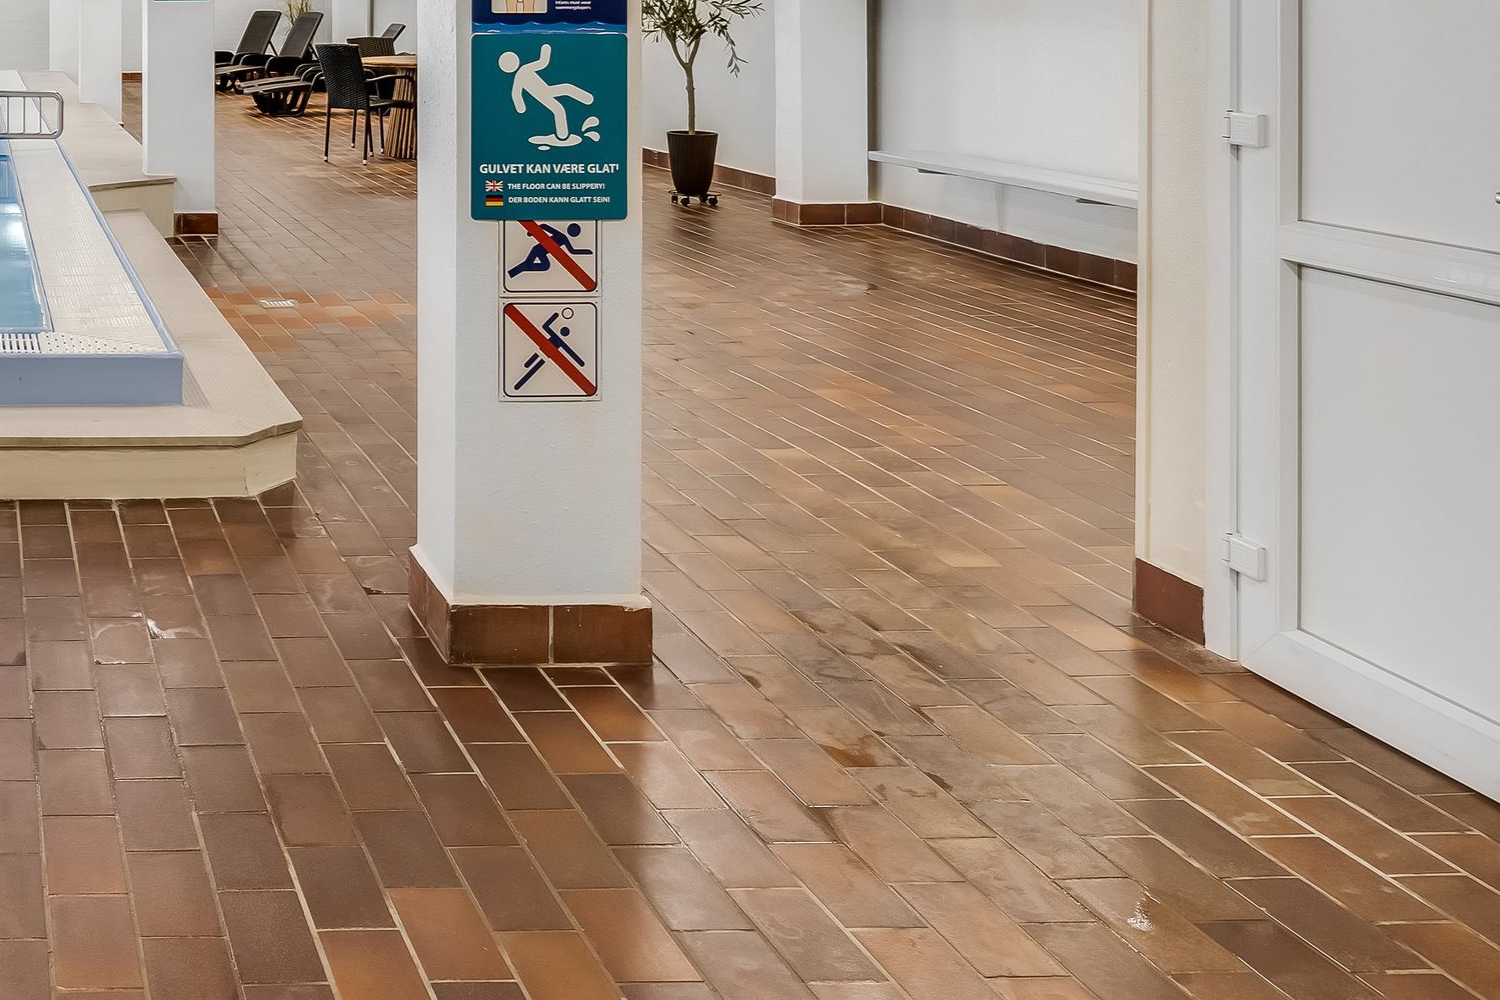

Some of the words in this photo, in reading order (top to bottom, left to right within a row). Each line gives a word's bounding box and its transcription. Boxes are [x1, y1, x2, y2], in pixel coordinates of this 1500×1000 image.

[479, 163, 524, 174] GULVET
[526, 163, 551, 174] KAN
[553, 163, 585, 174] VÆRE
